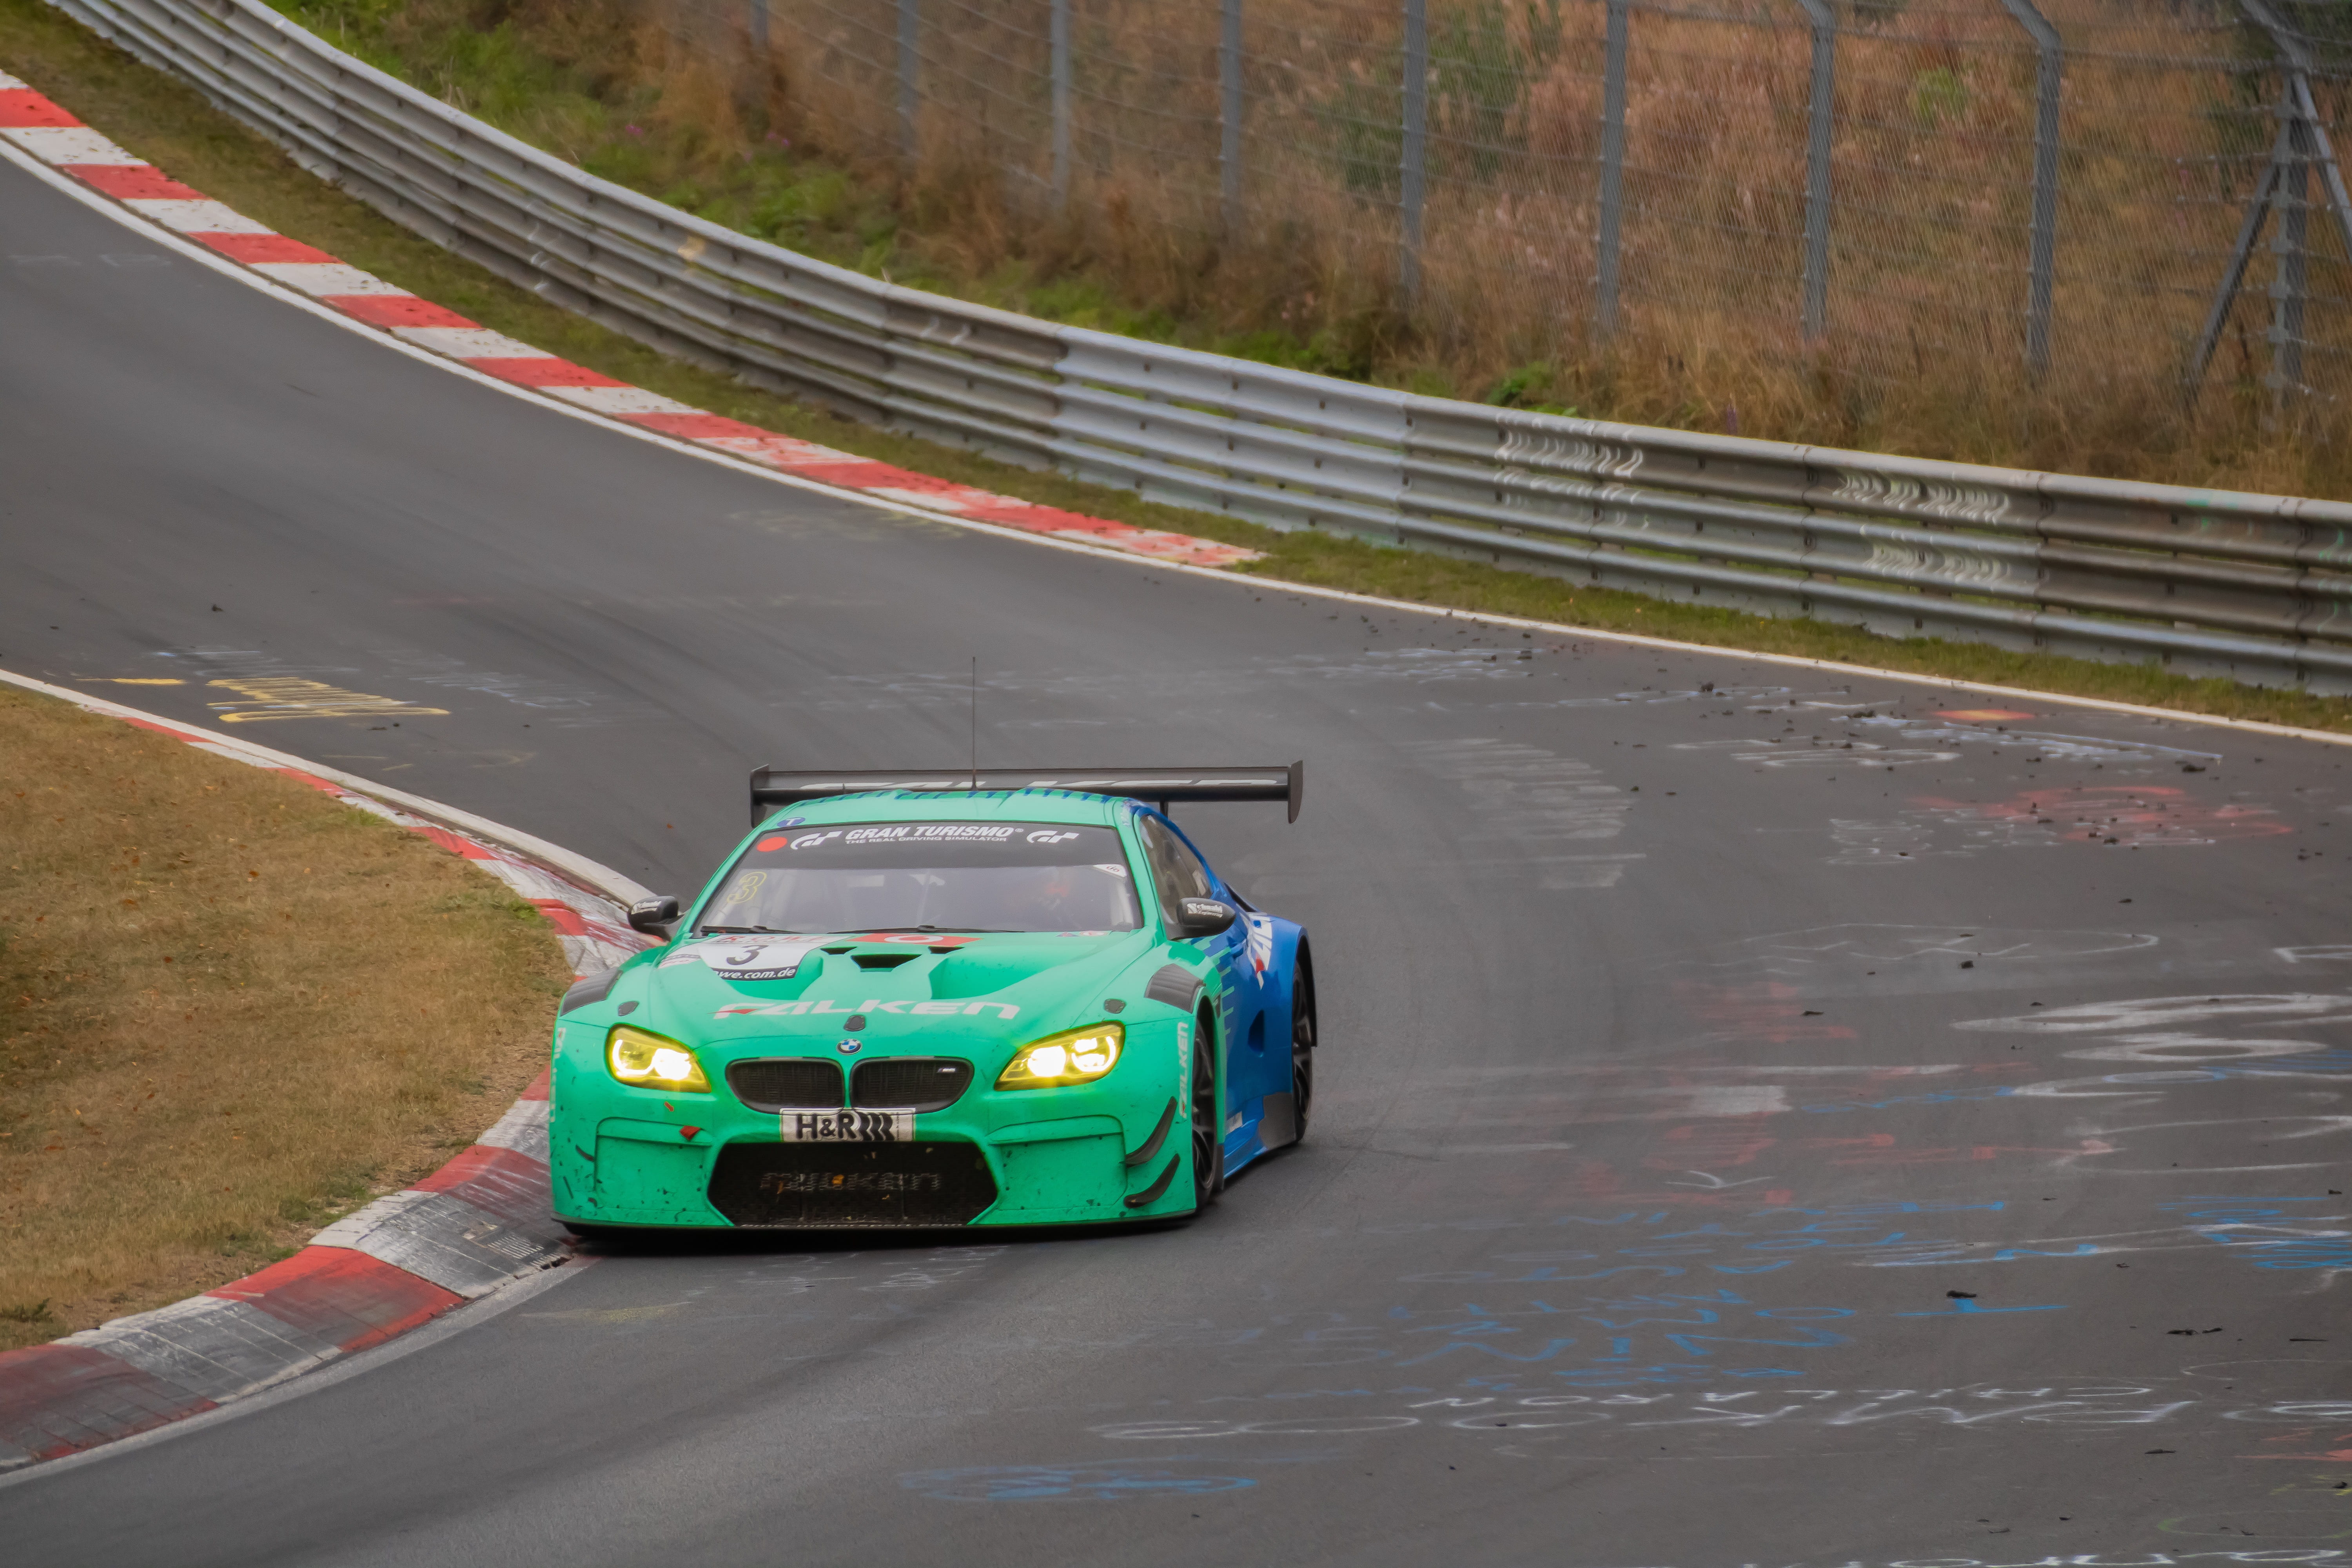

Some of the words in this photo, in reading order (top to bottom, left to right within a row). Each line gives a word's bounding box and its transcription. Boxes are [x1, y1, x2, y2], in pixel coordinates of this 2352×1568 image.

[845, 826, 911, 840] GRAN
[728, 871, 768, 905] 3
[726, 944, 769, 965] 3
[707, 999, 1020, 1020] FALKEN
[1177, 1021, 1189, 1119] FALKEN
[796, 1112, 858, 1140] H&R
